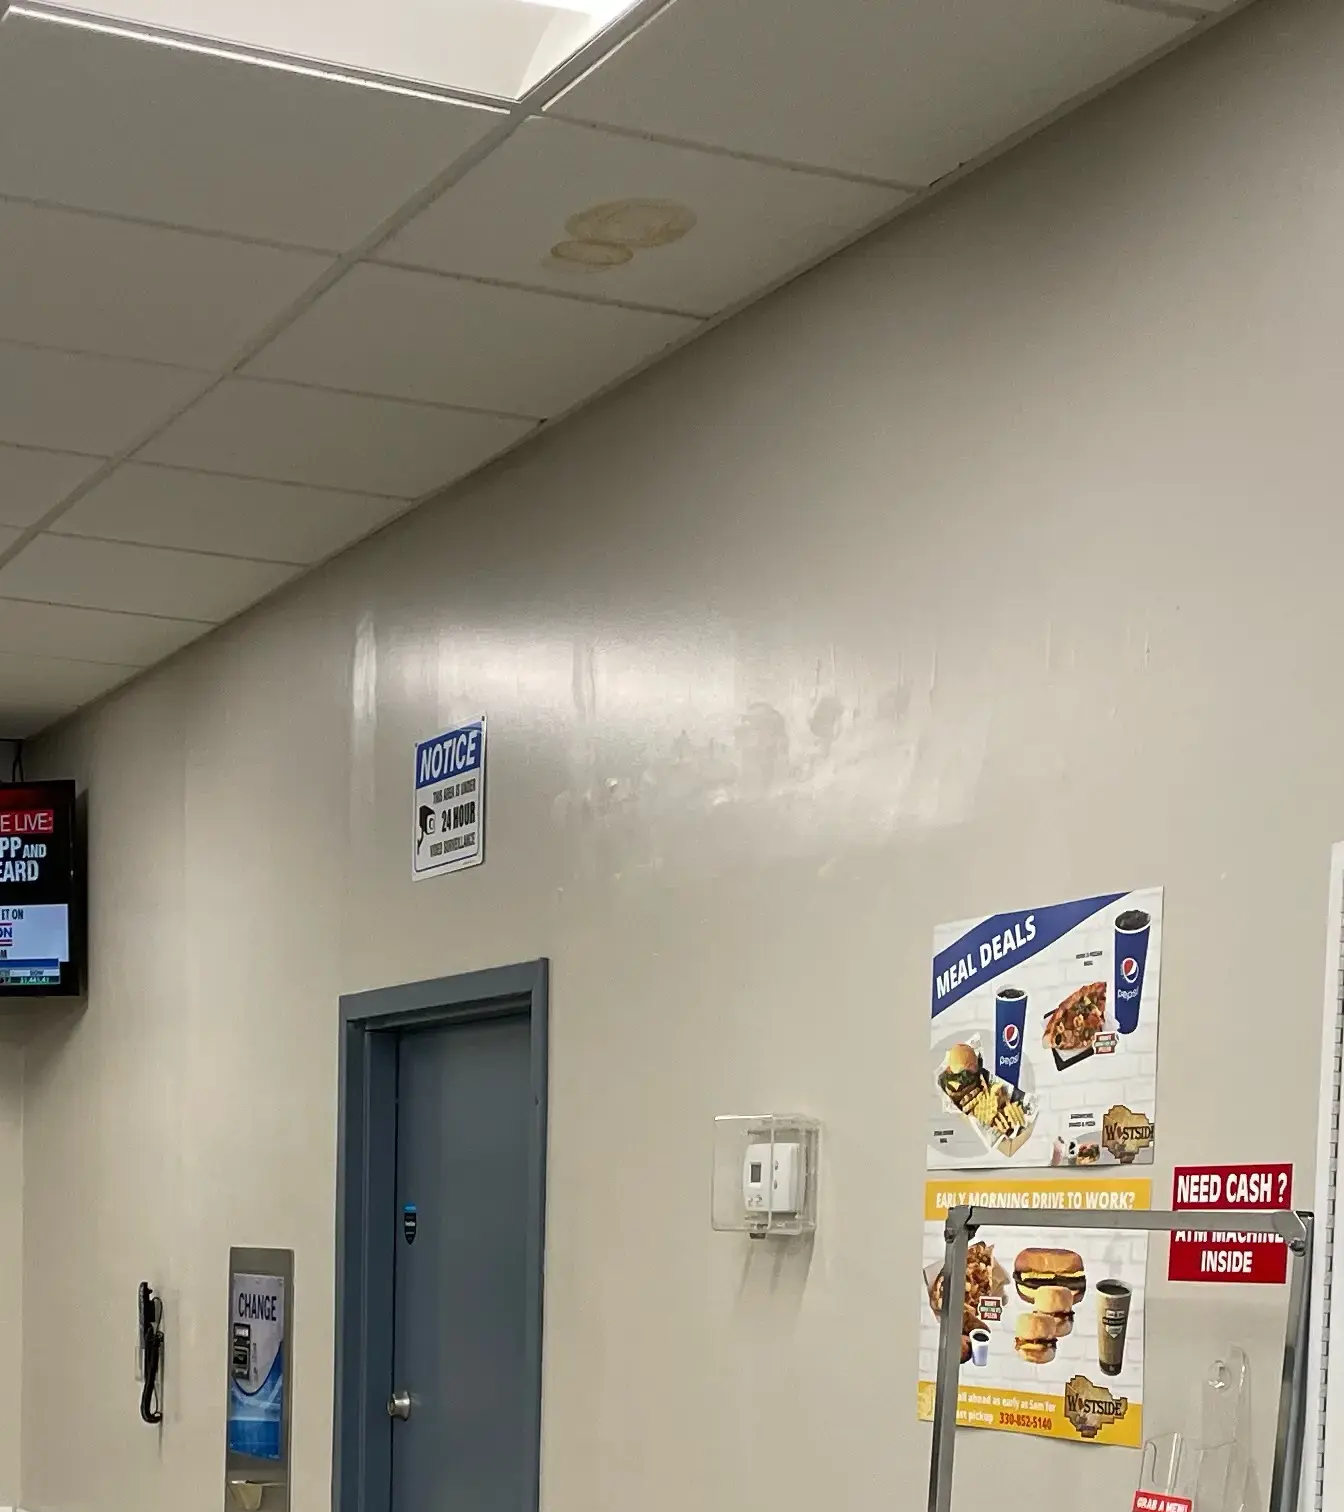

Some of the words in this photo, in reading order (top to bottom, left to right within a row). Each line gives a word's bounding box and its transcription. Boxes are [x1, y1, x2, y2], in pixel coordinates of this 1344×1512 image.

[419, 729, 478, 783] NOTICE
[442, 808, 452, 833] 24
[452, 801, 476, 830] HOUR
[22, 843, 48, 859] AND
[1, 908, 10, 921] ET
[11, 908, 24, 920] ON
[935, 953, 978, 1000] MEAL
[979, 915, 1037, 969] DEALS
[1117, 986, 1139, 1002] pepsi
[999, 1051, 1019, 1067] pepsi
[1176, 1173, 1222, 1204] NEED
[1225, 1172, 1273, 1203] CASH
[1277, 1172, 1288, 1203] ?
[935, 1191, 966, 1209] EARLY
[967, 1191, 1030, 1210] MORNING
[1030, 1191, 1065, 1209] DRIVE
[1066, 1191, 1083, 1209] TO
[1085, 1190, 1136, 1210] WORK?
[1200, 1249, 1254, 1273] INSIDE
[237, 1292, 277, 1322] CHANGE
[968, 1393, 992, 1405] ahead
[968, 1410, 994, 1425] pickup
